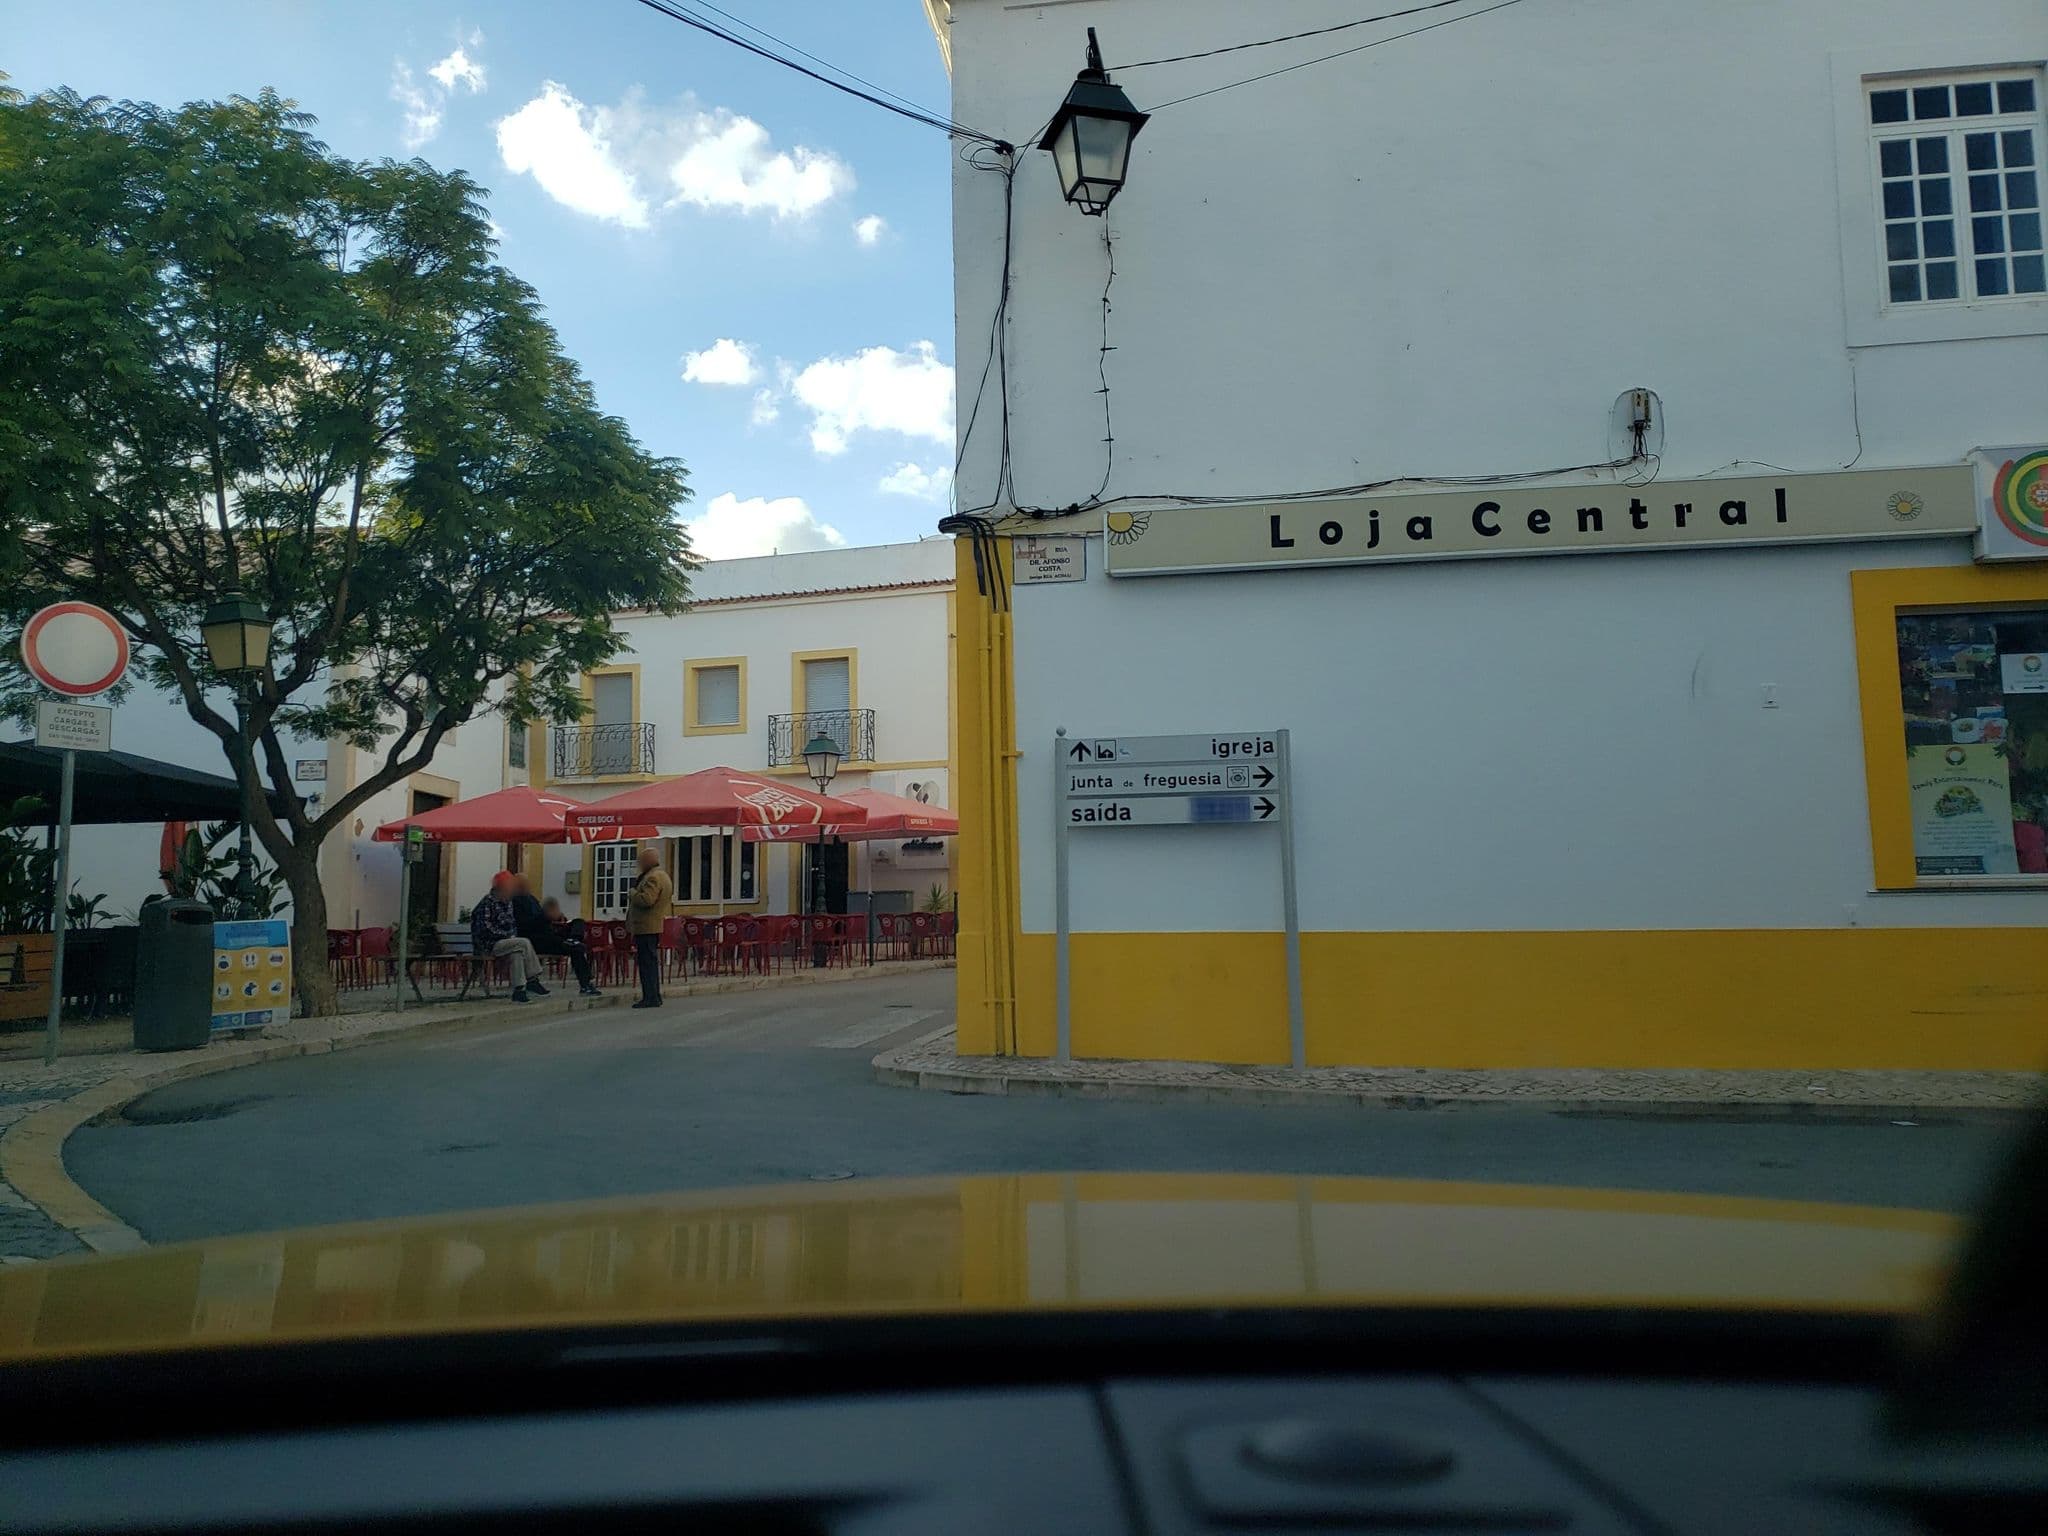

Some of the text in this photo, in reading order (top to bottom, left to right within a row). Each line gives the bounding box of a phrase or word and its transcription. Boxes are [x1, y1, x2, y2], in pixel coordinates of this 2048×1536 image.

[1270, 487, 1788, 549] Loja Central
[1043, 557, 1070, 565] AFONSO
[57, 707, 95, 718] EXCEPTO
[54, 716, 88, 726] CARGAS
[49, 723, 101, 736] DESCARGAS
[1212, 737, 1274, 758] igreja
[1070, 772, 1221, 791] junta de freguesia
[1071, 803, 1131, 822] saída
